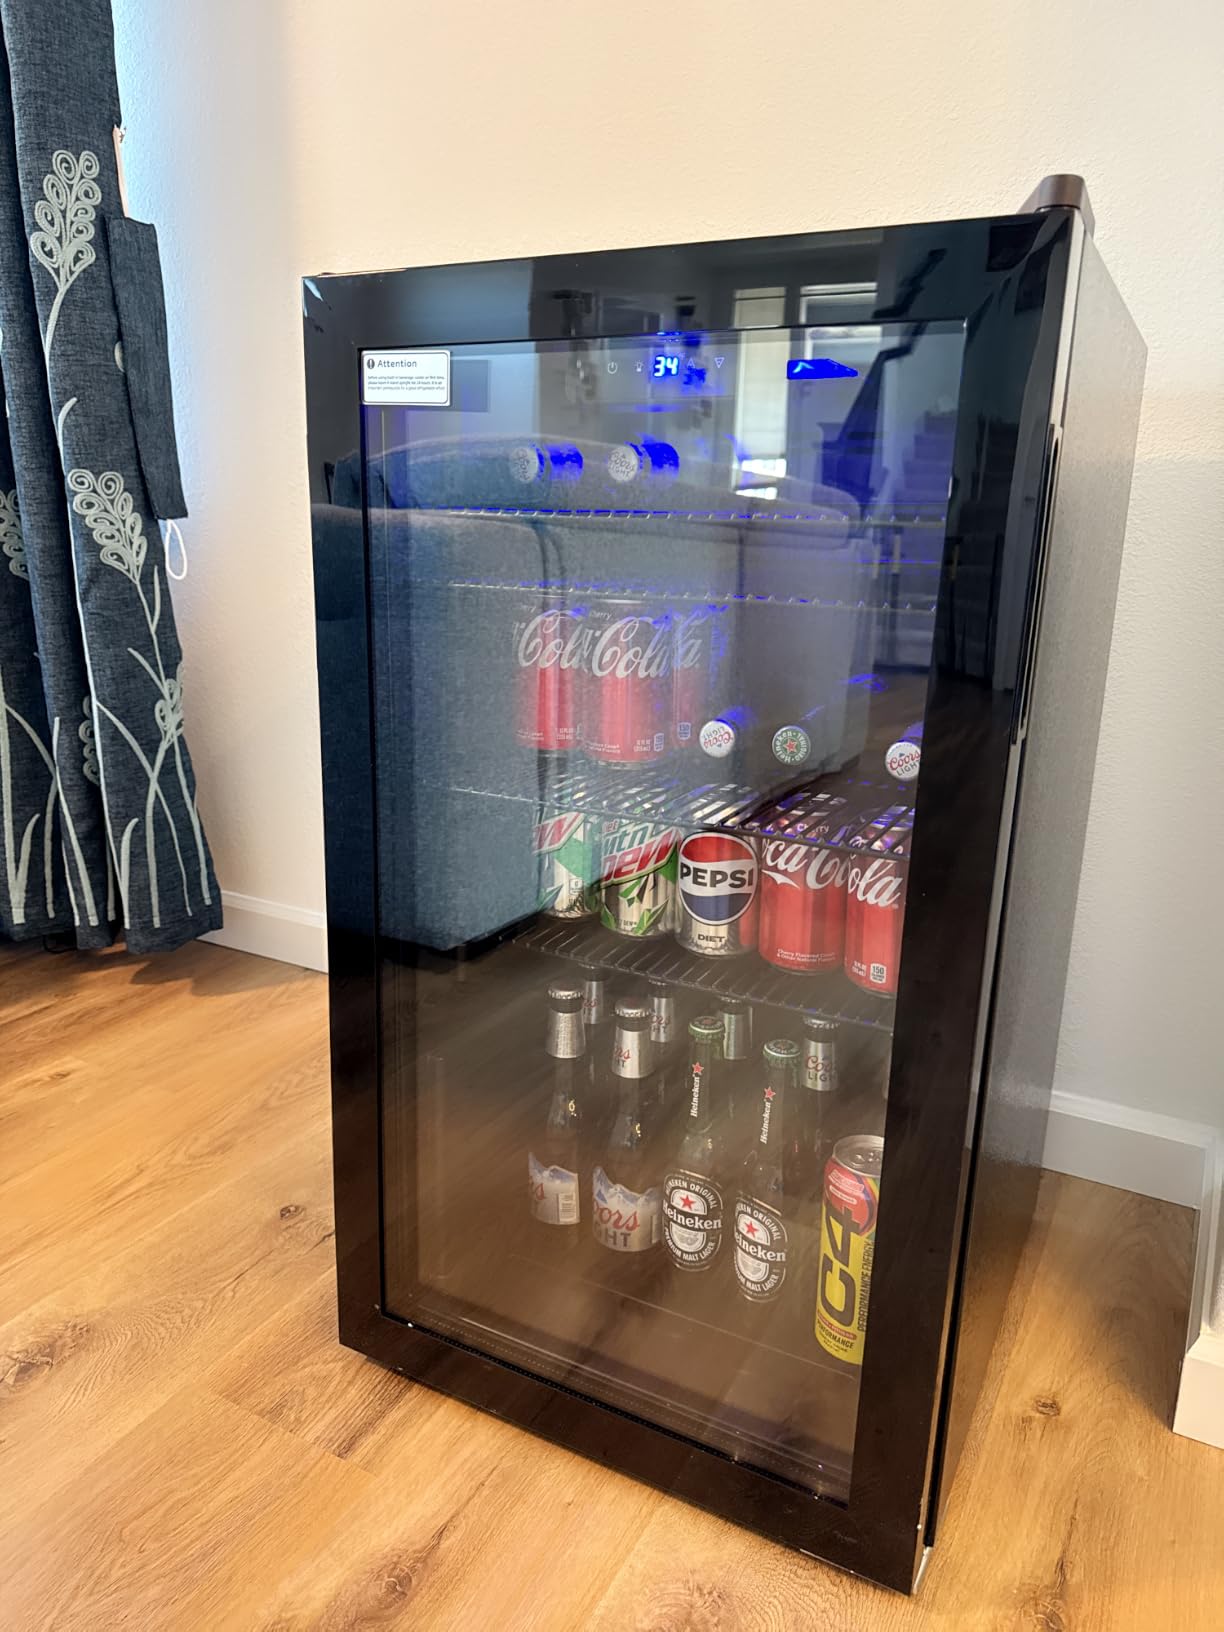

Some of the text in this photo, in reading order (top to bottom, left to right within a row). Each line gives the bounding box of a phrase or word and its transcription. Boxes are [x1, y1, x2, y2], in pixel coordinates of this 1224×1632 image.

[377, 359, 417, 368] Attention
[653, 356, 680, 377] 34
[703, 731, 734, 749] Coors
[775, 731, 793, 764] Heineken
[888, 749, 920, 771] Coors
[680, 862, 754, 888] PEPSI
[697, 933, 726, 943] DIET
[872, 965, 885, 975] 150
[690, 1074, 701, 1118] Heineken
[760, 1099, 772, 1145] Heineken
[689, 1183, 718, 1209] ORIGINAL
[662, 1199, 722, 1230] Heineken
[753, 1209, 781, 1241] ORIGINAL
[682, 1252, 699, 1262] MALT
[699, 1241, 716, 1260] LAGER
[734, 1231, 786, 1262] eineken
[820, 1203, 861, 1328] C4
[761, 1274, 780, 1291] LAGER
[857, 1270, 870, 1331] PERFORMANCE
